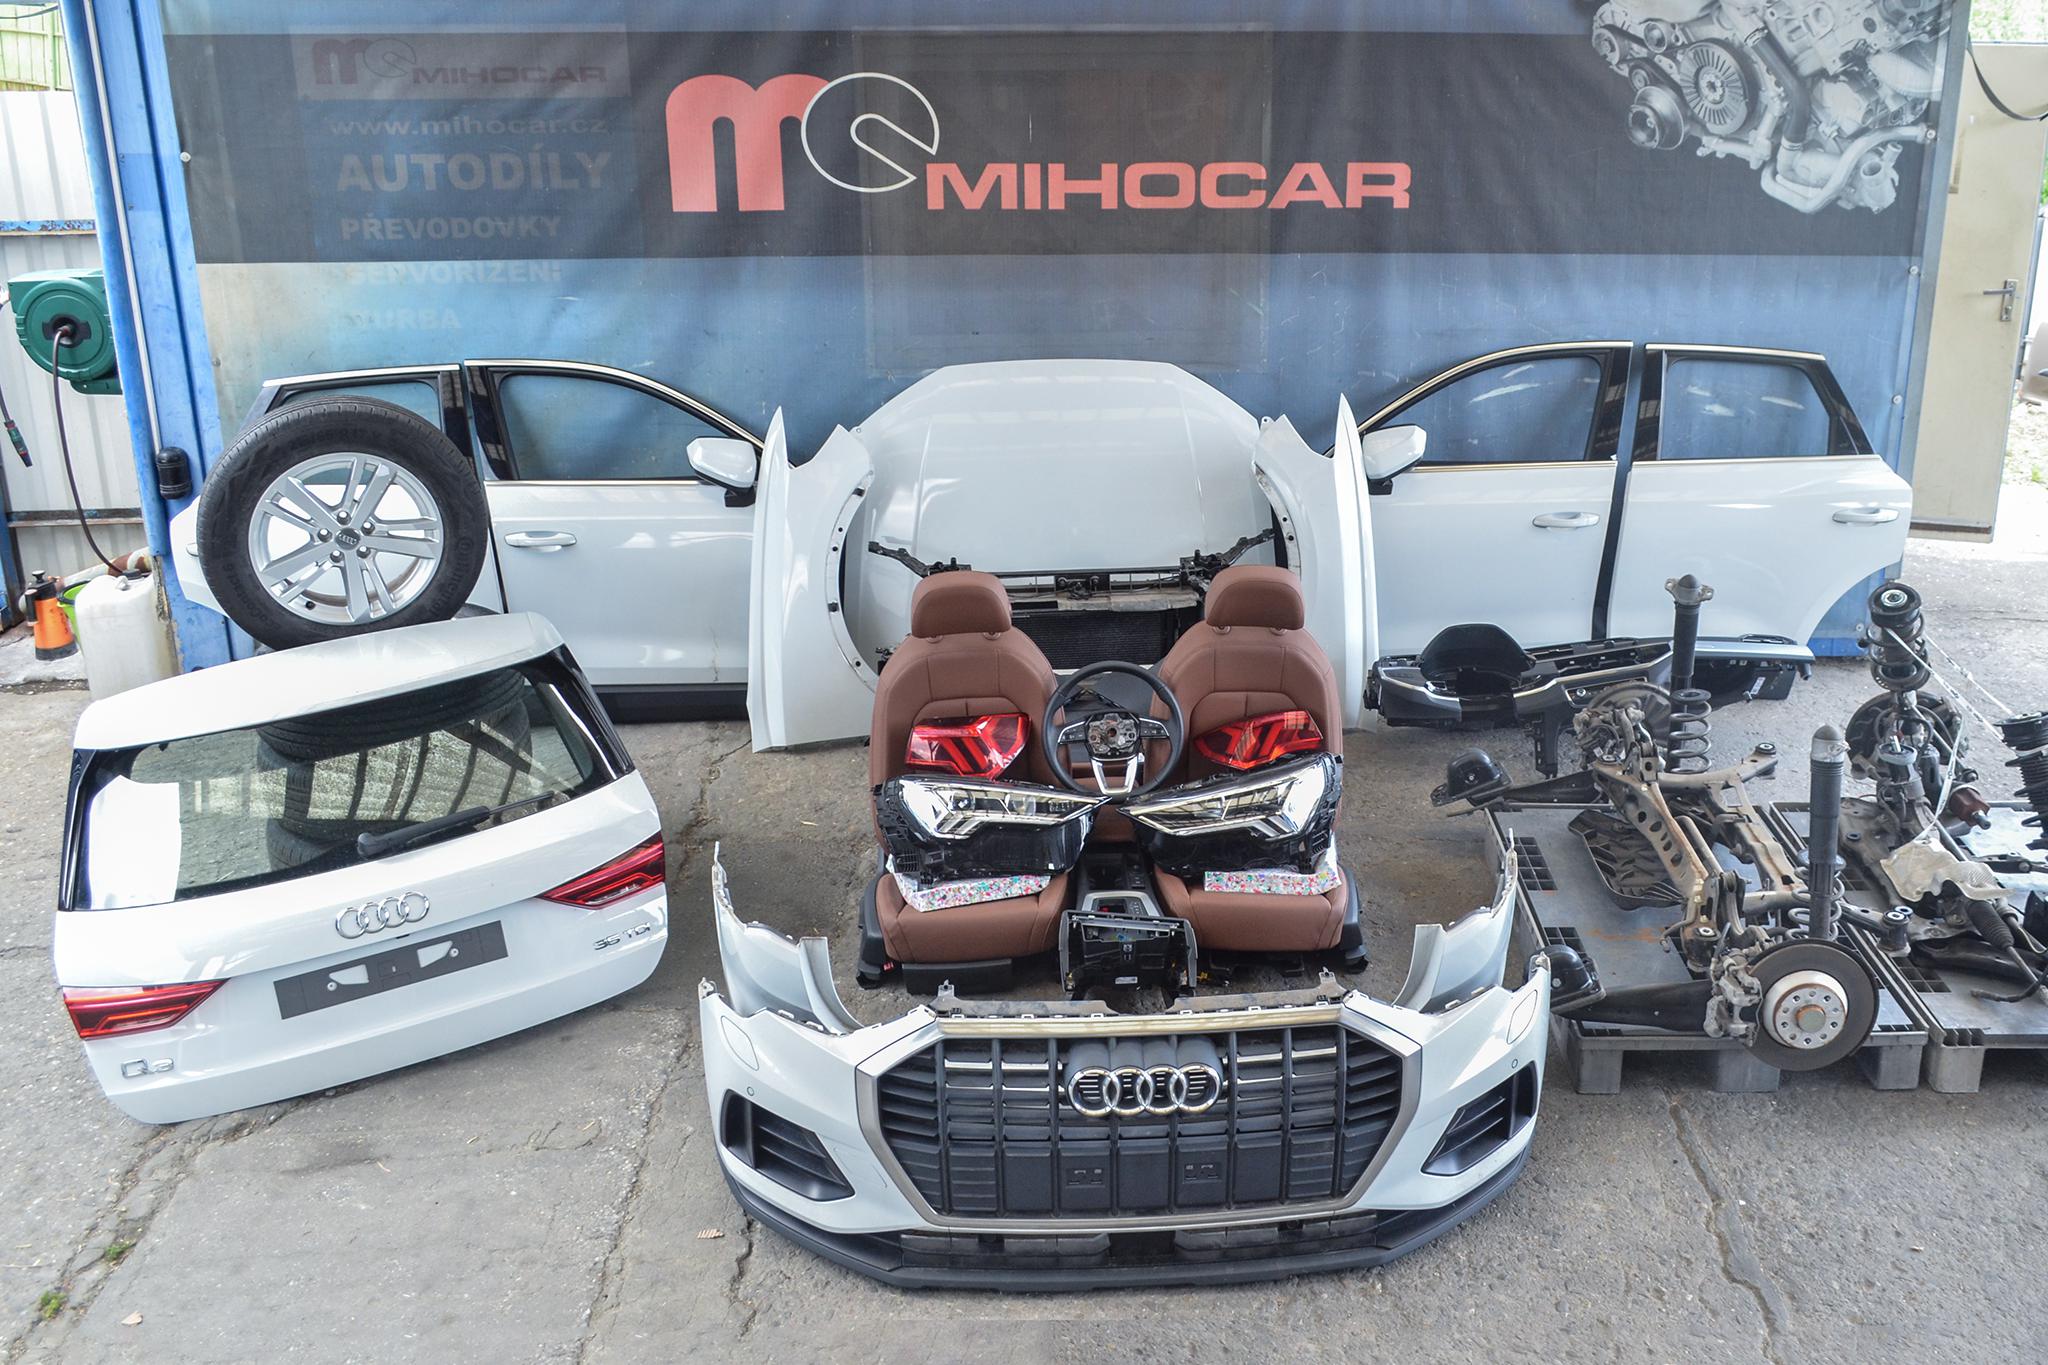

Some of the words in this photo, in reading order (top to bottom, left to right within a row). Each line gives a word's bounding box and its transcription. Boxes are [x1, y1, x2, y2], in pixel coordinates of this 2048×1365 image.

[411, 66, 608, 84] MIHOCAR
[331, 115, 608, 137] www.mihocar.cz
[337, 143, 613, 193] AUTODÍLY
[926, 162, 1412, 211] MIHOCAR
[341, 212, 562, 241] PŘEVODOVKY
[593, 933, 621, 951] 35
[120, 1058, 175, 1079] Q3
